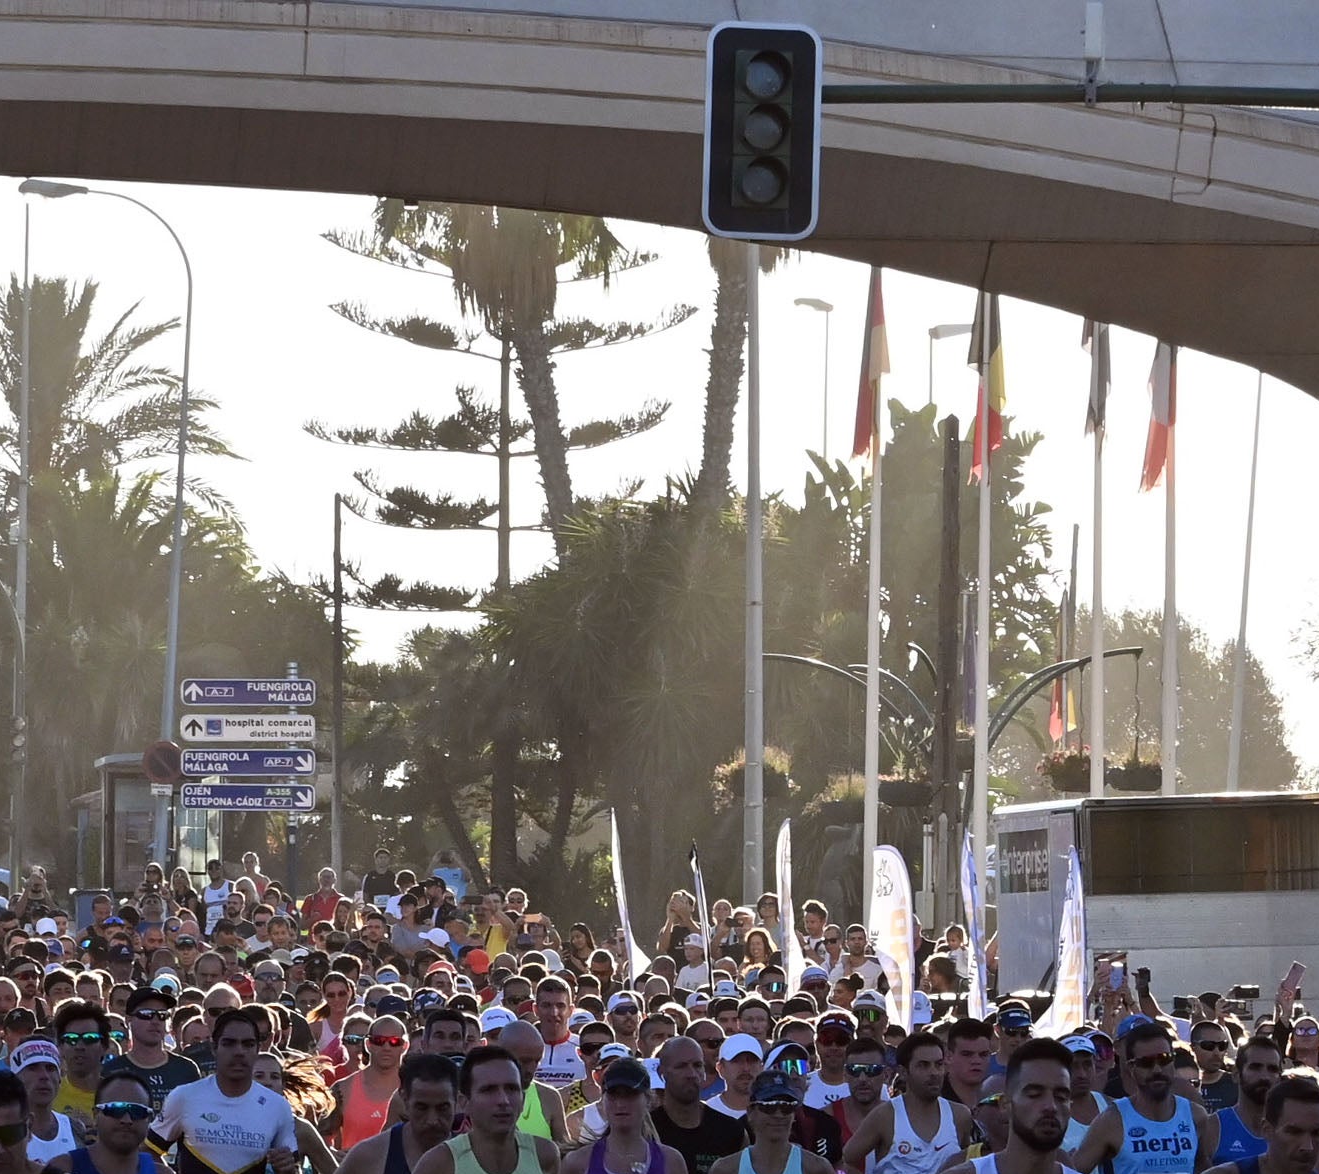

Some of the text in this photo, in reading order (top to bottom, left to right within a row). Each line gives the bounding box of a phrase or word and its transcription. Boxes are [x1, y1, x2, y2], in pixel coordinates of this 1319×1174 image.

[210, 688, 229, 696] A-7
[247, 682, 312, 692] FUENGIROLA
[268, 691, 312, 701] MÁLAGA
[225, 718, 312, 728] hospital comarcal
[250, 730, 312, 739] district hospital
[185, 752, 250, 762] FUENGIROLA
[265, 758, 291, 766] AP-7
[185, 761, 229, 772] MÁLAGA
[266, 788, 292, 796] A-355
[184, 795, 288, 807] ESTEPONA-CÁDIZ A-7
[207, 1129, 265, 1141] MONTEROS
[1131, 1132, 1192, 1155] nerja
